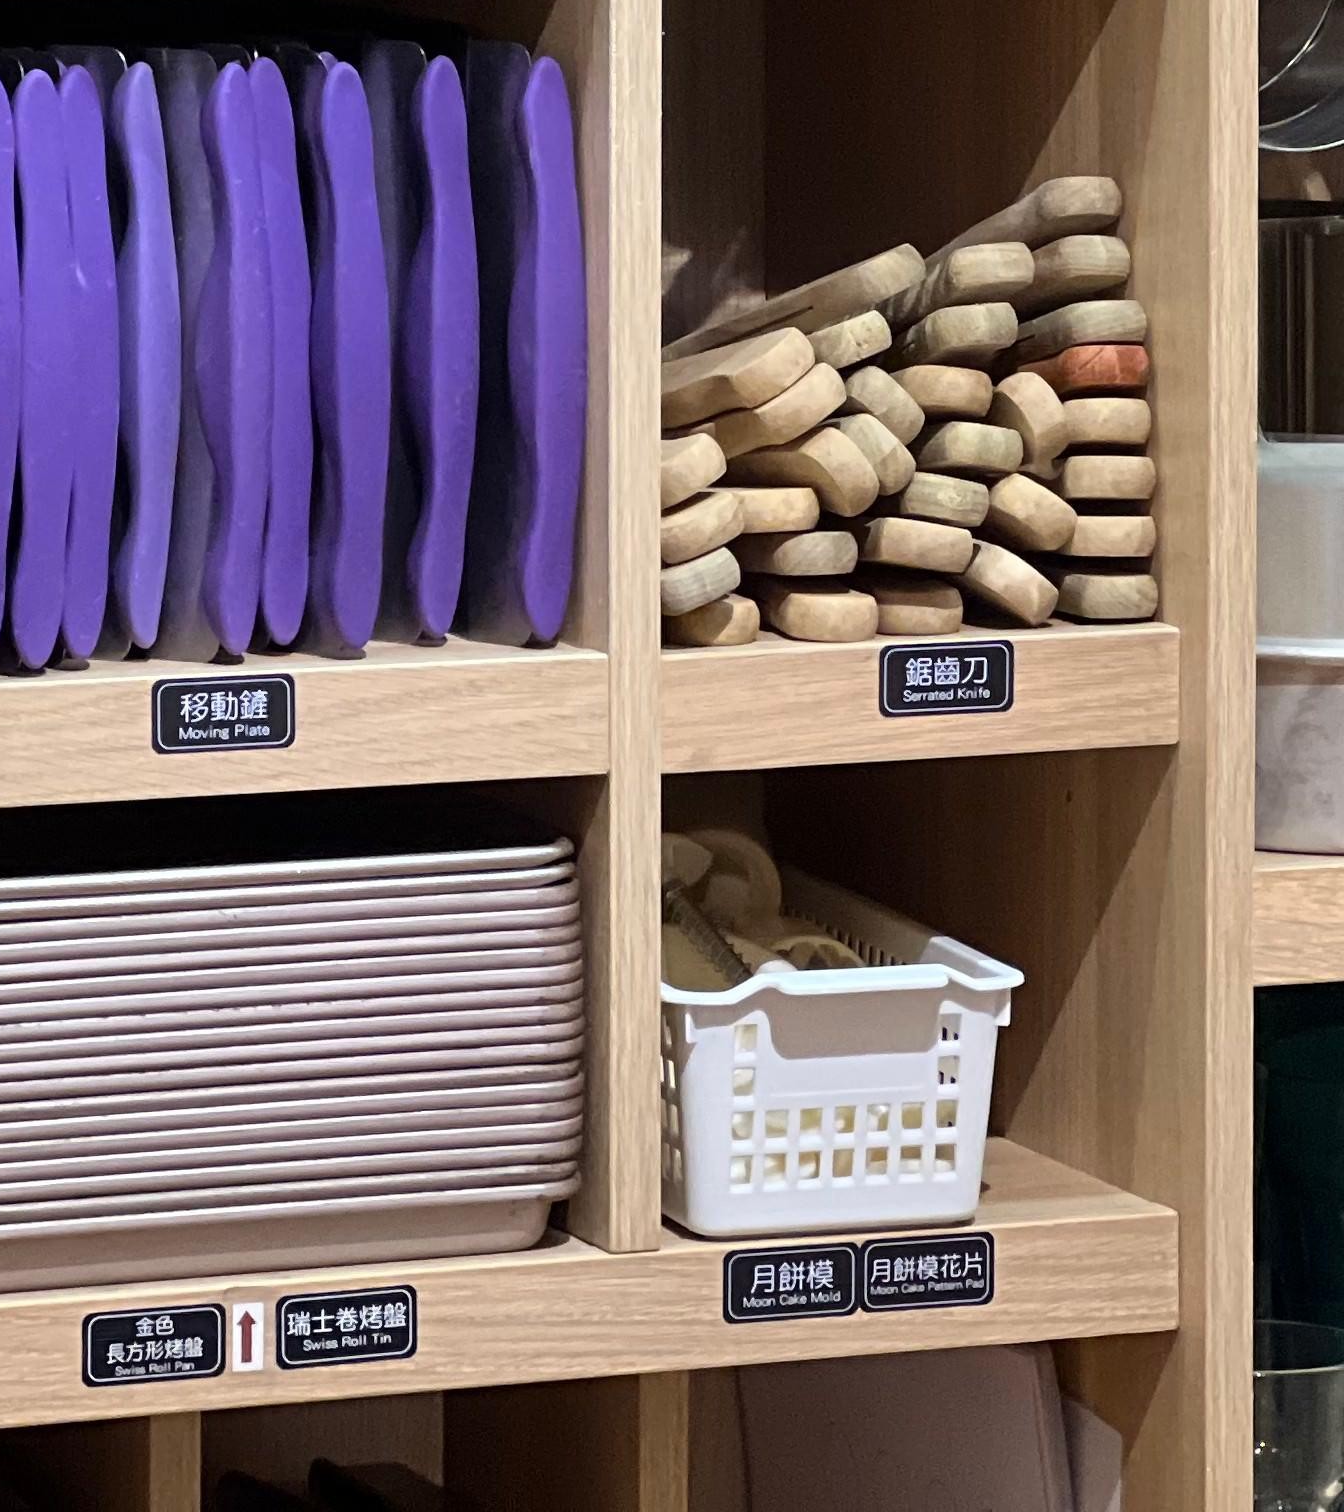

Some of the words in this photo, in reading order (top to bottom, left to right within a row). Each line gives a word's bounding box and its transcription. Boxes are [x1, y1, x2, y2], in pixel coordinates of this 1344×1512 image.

[906, 656, 988, 687] 鋸齒刀
[903, 689, 954, 702] Serrated
[957, 687, 991, 699] Knife
[178, 726, 229, 740] Moving
[234, 724, 270, 737] Plate
[751, 1259, 834, 1294] 月餅模
[870, 1252, 983, 1283] 月餅模花片
[742, 1296, 776, 1308] Moon
[779, 1294, 807, 1306] Cake
[810, 1291, 841, 1303] Mold
[135, 1315, 175, 1337] 金色
[287, 1302, 407, 1337] 瑞士卷烤盤
[106, 1337, 204, 1364] 長方形烤盤
[303, 1338, 338, 1352] Swiss
[342, 1335, 367, 1347] Roll
[372, 1333, 392, 1344] Tin
[115, 1365, 146, 1377] Swiss
[149, 1362, 172, 1374] Roll
[174, 1361, 195, 1371] Pan
